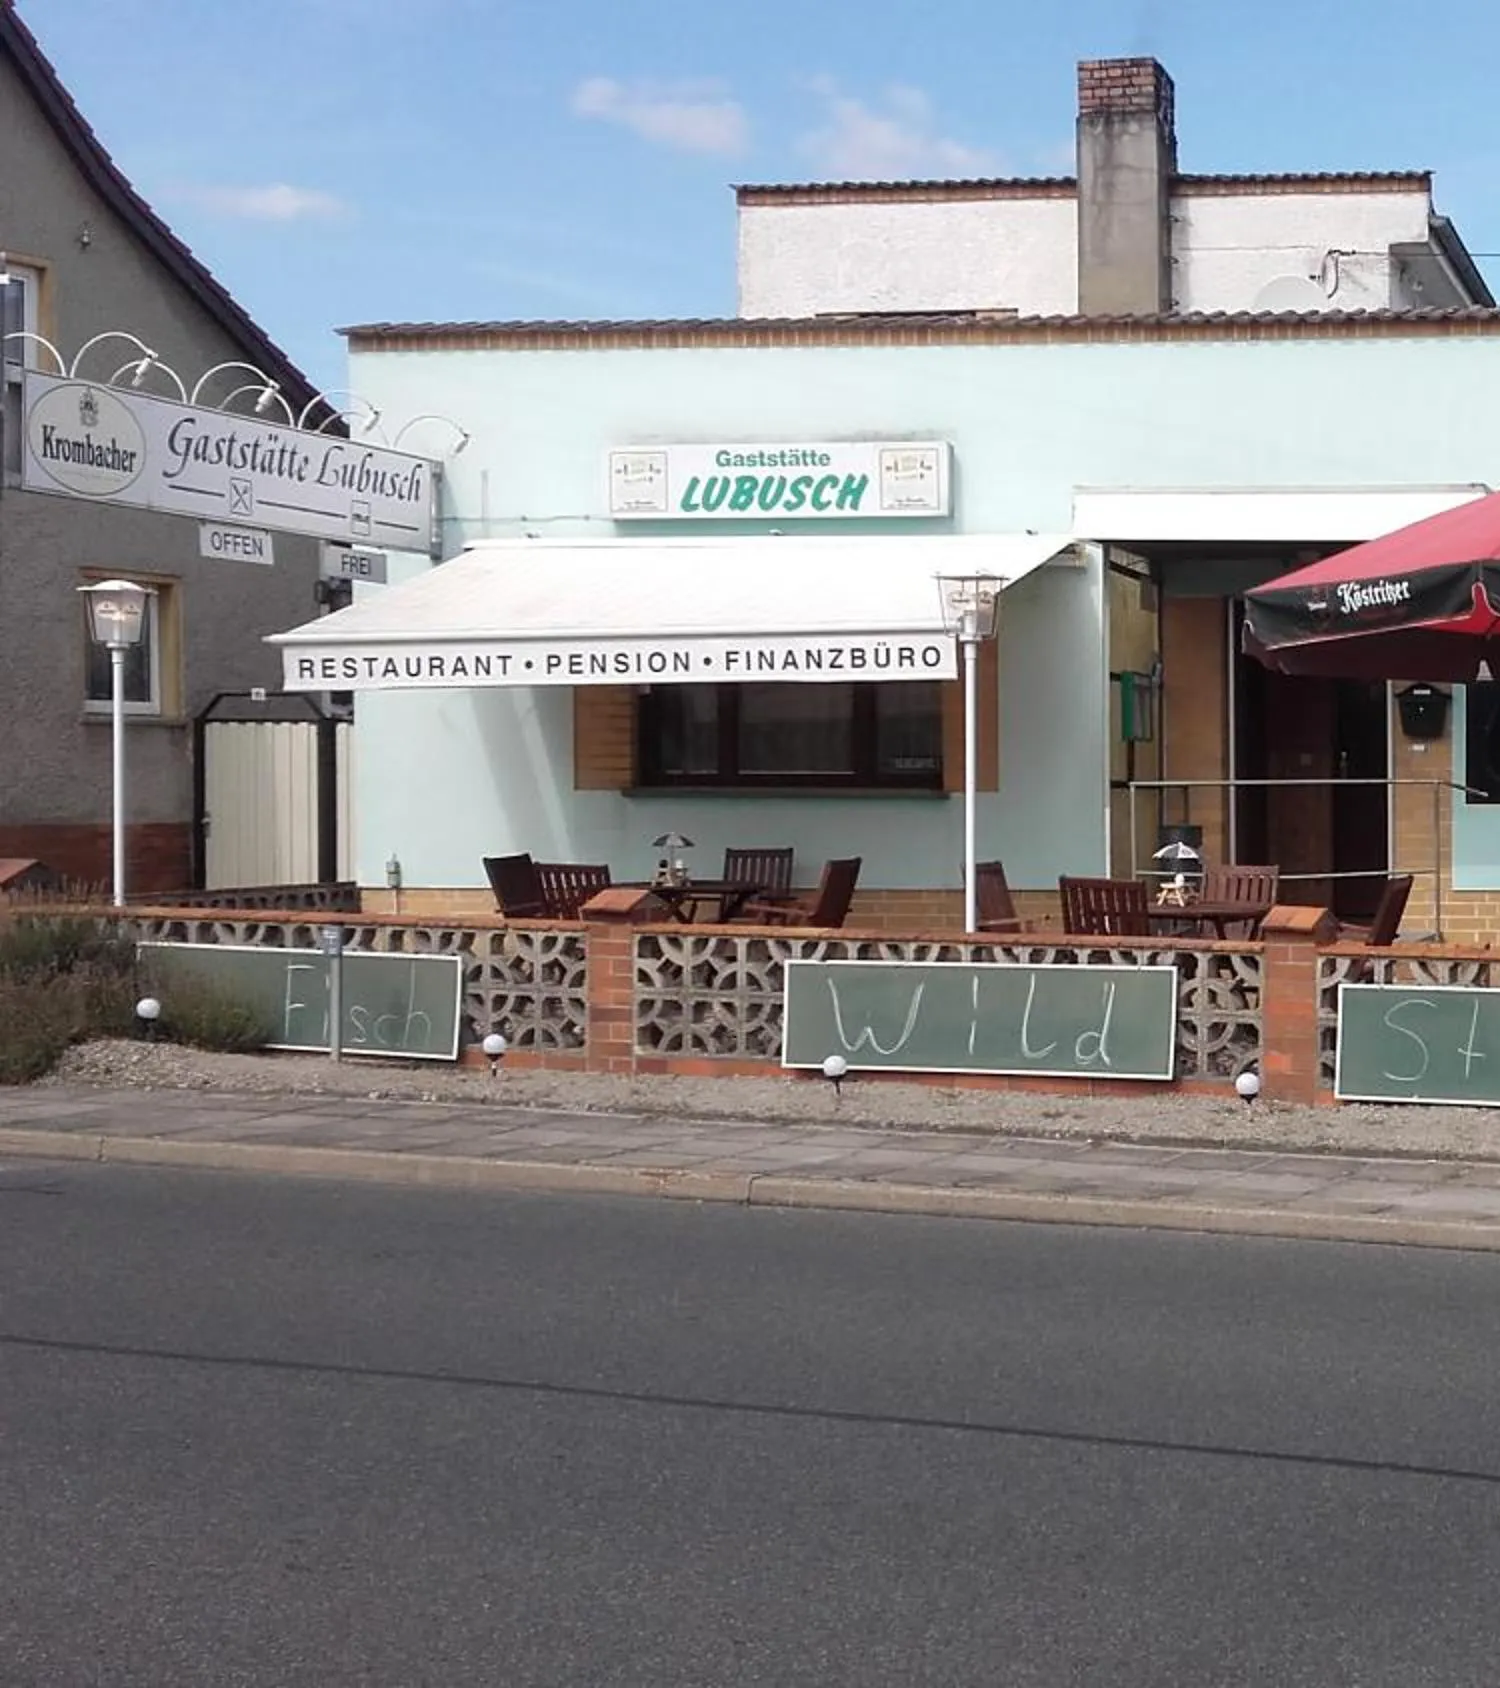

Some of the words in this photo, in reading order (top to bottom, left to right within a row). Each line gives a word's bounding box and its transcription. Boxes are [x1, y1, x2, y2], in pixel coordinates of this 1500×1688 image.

[41, 424, 137, 472] Krombacher
[162, 417, 309, 482] Gaststätte
[314, 445, 423, 502] Lubusch
[715, 449, 831, 467] Gaststätte
[679, 473, 869, 513] LUBUSCH
[210, 531, 263, 557] OFFEN
[341, 553, 371, 576] FREI
[1337, 580, 1410, 614] Köstritzer
[299, 655, 512, 679] RESTAURANT
[546, 650, 691, 675] PENSION
[724, 642, 941, 671] FINANZBÜRO
[284, 958, 432, 1047] Fisch
